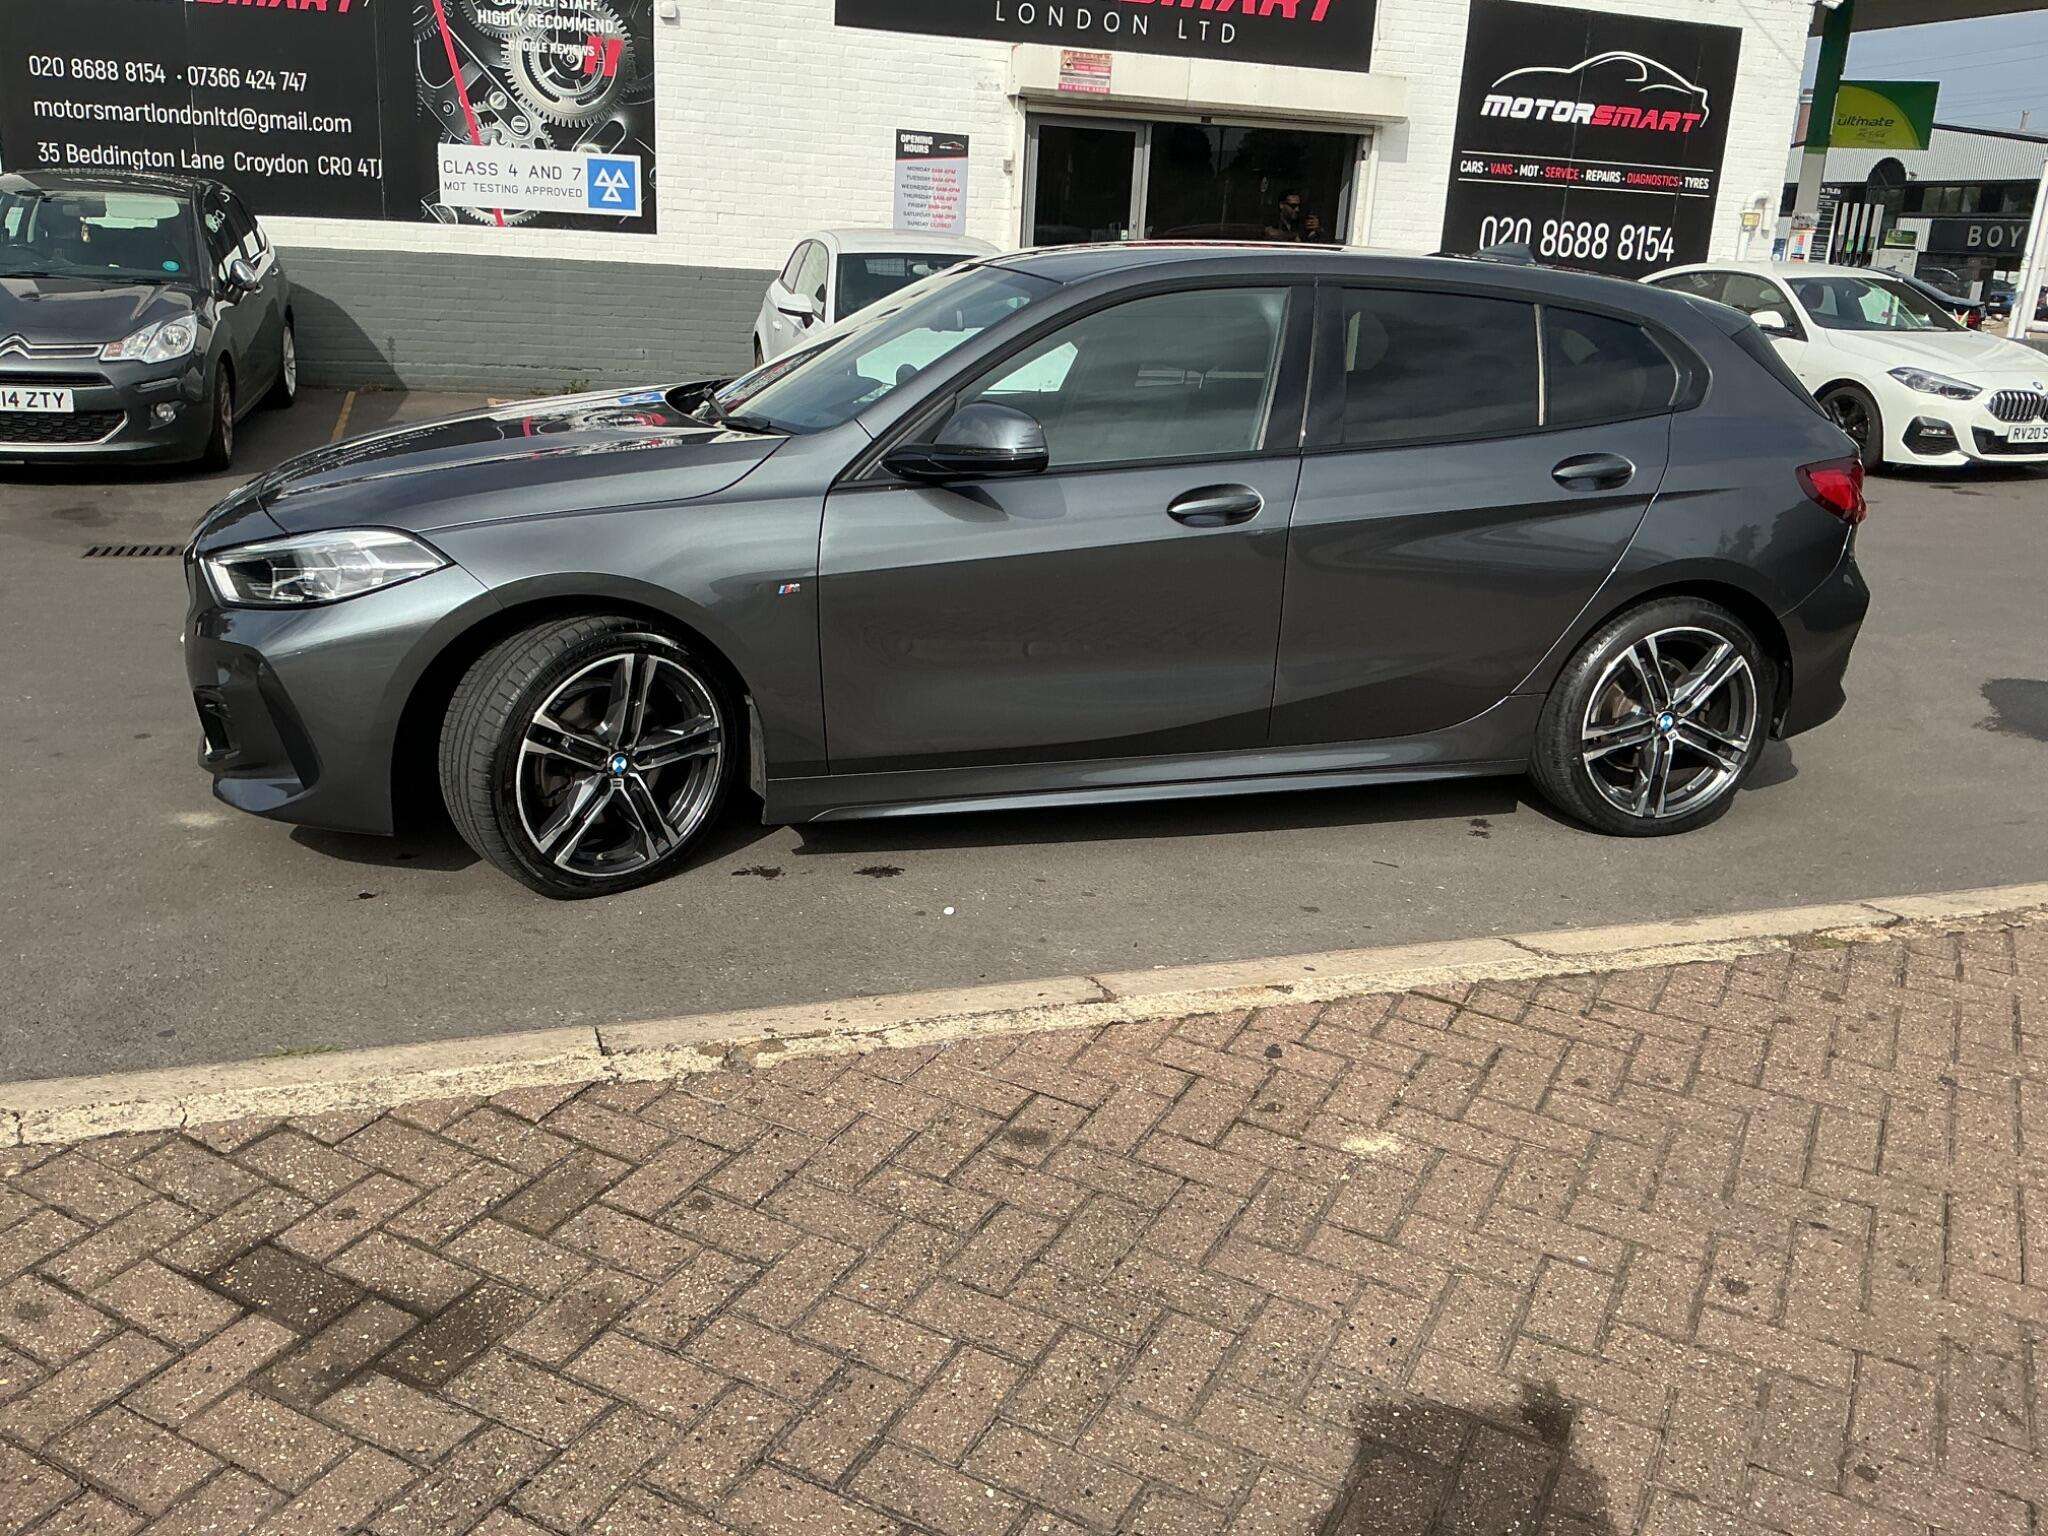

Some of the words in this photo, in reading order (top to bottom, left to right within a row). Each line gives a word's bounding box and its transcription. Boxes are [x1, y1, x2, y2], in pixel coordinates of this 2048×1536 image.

[478, 9, 524, 26] HIGHLY
[528, 14, 618, 34] RECOMMEND.
[996, 1, 1147, 36] LONDON
[1179, 21, 1236, 44] LTD
[509, 40, 548, 53] GOOGLE
[550, 43, 595, 56] REVIEWS
[29, 55, 64, 78] 020
[71, 58, 118, 81] 8688
[125, 62, 165, 84] 8154
[187, 66, 240, 88] 07366
[245, 70, 276, 91] 424
[280, 72, 307, 92] 747
[34, 99, 352, 133] motorsmartlondonltd@gmail.com
[1480, 94, 1701, 133] MOTORSMART
[1837, 115, 1895, 127] ultimate
[900, 134, 933, 145] OPENING
[903, 144, 929, 153] HOURS
[37, 142, 60, 163] 35
[66, 144, 175, 171] Beddington
[181, 149, 224, 171] Lane
[234, 152, 308, 177] Croydon
[357, 159, 383, 180] 4TJ
[443, 160, 498, 176] CLASS
[508, 163, 518, 177] 4
[529, 165, 562, 180] AND
[572, 167, 582, 181] 7
[1460, 160, 1484, 174] CARS
[1490, 162, 1514, 176] VANS
[1519, 164, 1540, 178] MOT
[1544, 166, 1580, 181] SERVICE
[1585, 169, 1621, 184] REPAIRS
[1626, 172, 1679, 188] DIAGNOSTICS
[1684, 176, 1710, 190] TYRES
[444, 182, 466, 192] MOT
[473, 183, 519, 194] TESTING
[525, 185, 583, 198] APPROVED
[1540, 219, 1611, 260] 8688
[1617, 224, 1675, 262] 8154
[1967, 225, 2025, 248] BOY
[1, 390, 19, 407] 14
[26, 391, 64, 408] ZTY
[2013, 427, 2041, 440] RV20
